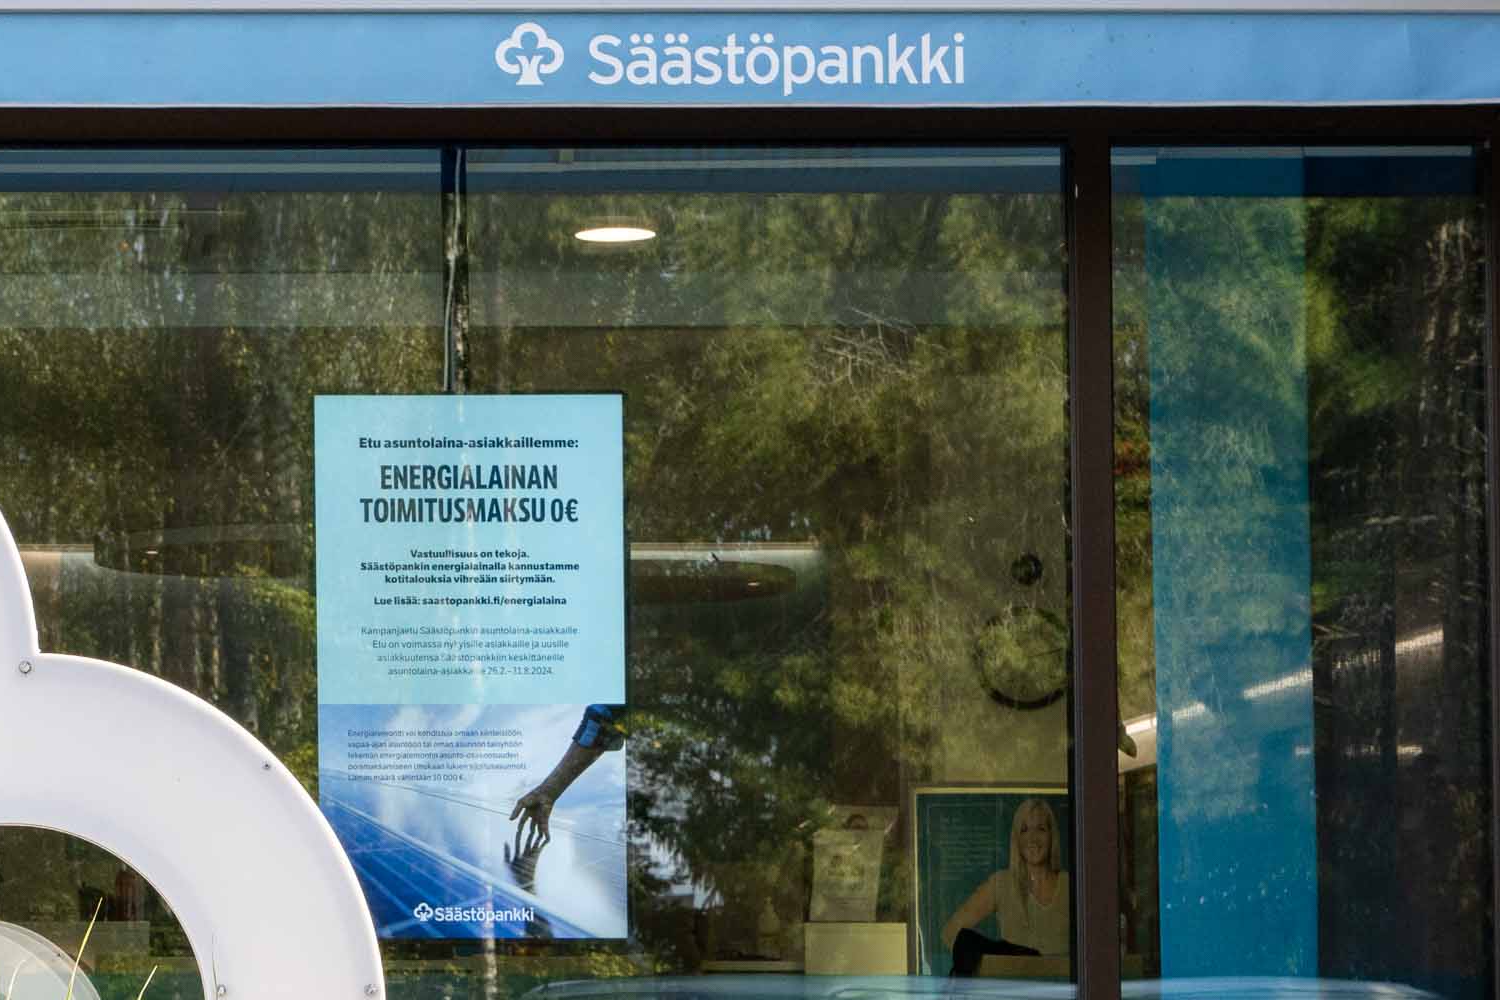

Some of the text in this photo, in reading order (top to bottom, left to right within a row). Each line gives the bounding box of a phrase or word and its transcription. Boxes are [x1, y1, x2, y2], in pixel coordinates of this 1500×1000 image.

[587, 32, 965, 96] Säästöpankki
[359, 436, 579, 449] Etu asuntolaina-asiakkaillemme:
[380, 464, 558, 490] ENERGIALAINAN
[360, 497, 546, 523] TOIMITUSMAKSU
[480, 551, 493, 559] on
[495, 549, 530, 560] tekoja.
[360, 561, 430, 573] Säästöpankin
[508, 562, 580, 572] kannustamme
[385, 574, 556, 585] kotitalouksia vihreään siirtymään.
[374, 597, 393, 606] Lue
[388, 641, 400, 649] on
[434, 906, 534, 924] Säästöpankki
